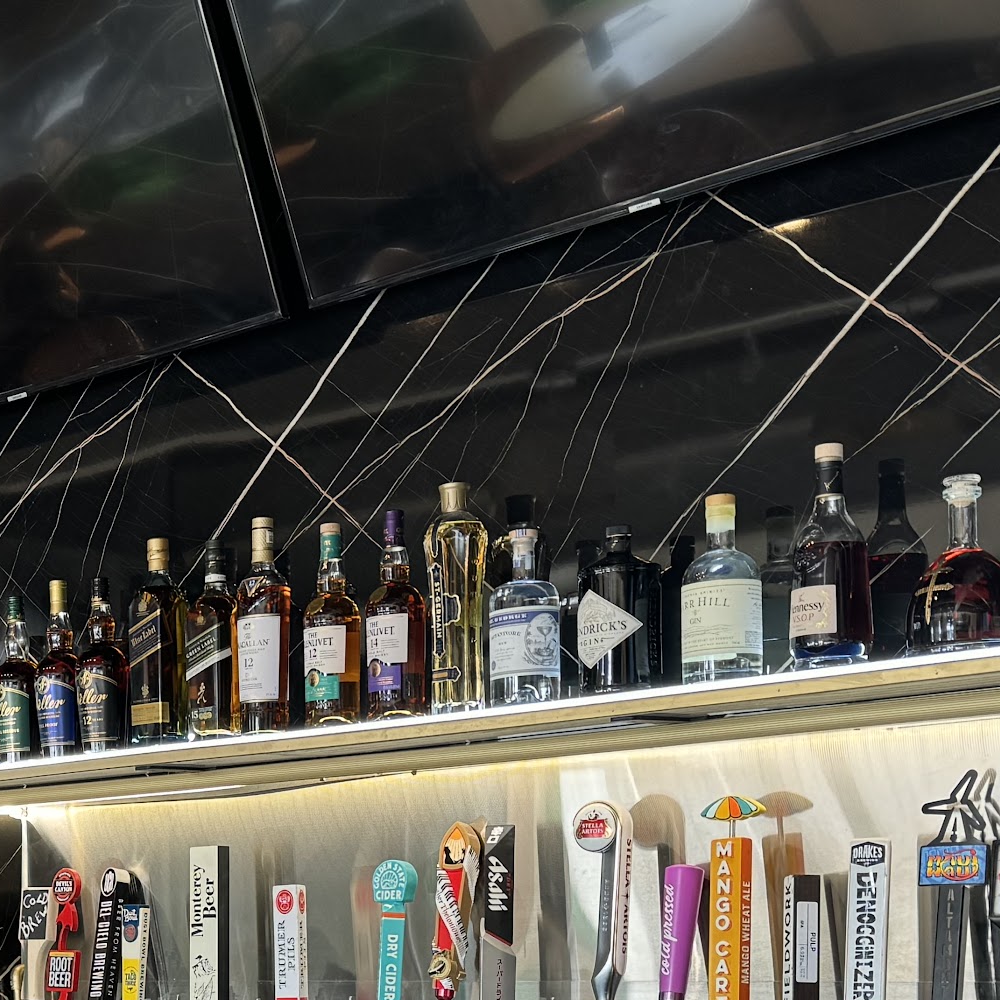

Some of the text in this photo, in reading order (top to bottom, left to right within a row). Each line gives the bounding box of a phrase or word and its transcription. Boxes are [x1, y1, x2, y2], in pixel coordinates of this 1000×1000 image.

[698, 595, 731, 608] HILL
[369, 620, 379, 629] THE
[689, 616, 702, 625] GIN
[202, 637, 217, 648] LABEL
[308, 632, 318, 640] THE
[370, 638, 379, 649] 14
[583, 636, 601, 647] GIN
[309, 648, 317, 659] 12
[244, 658, 254, 668] 12
[83, 716, 92, 726] 12
[373, 862, 406, 889] GOLDEN STATE
[487, 855, 509, 912] Asahi
[715, 841, 732, 932] MANGO
[23, 892, 49, 909] COLD
[191, 864, 206, 937] Monterey
[203, 877, 217, 919] Beer
[375, 890, 402, 900] CIDER
[660, 884, 678, 975] cold pressed
[741, 880, 751, 985] MANGO WHEAT ALE
[278, 919, 287, 989] TRUMER
[287, 937, 296, 971] PILS
[50, 957, 73, 972] ROOT
[384, 934, 399, 1000] DRY CIDER
[48, 972, 72, 988] BEER
[107, 958, 117, 997] HEAVEN
